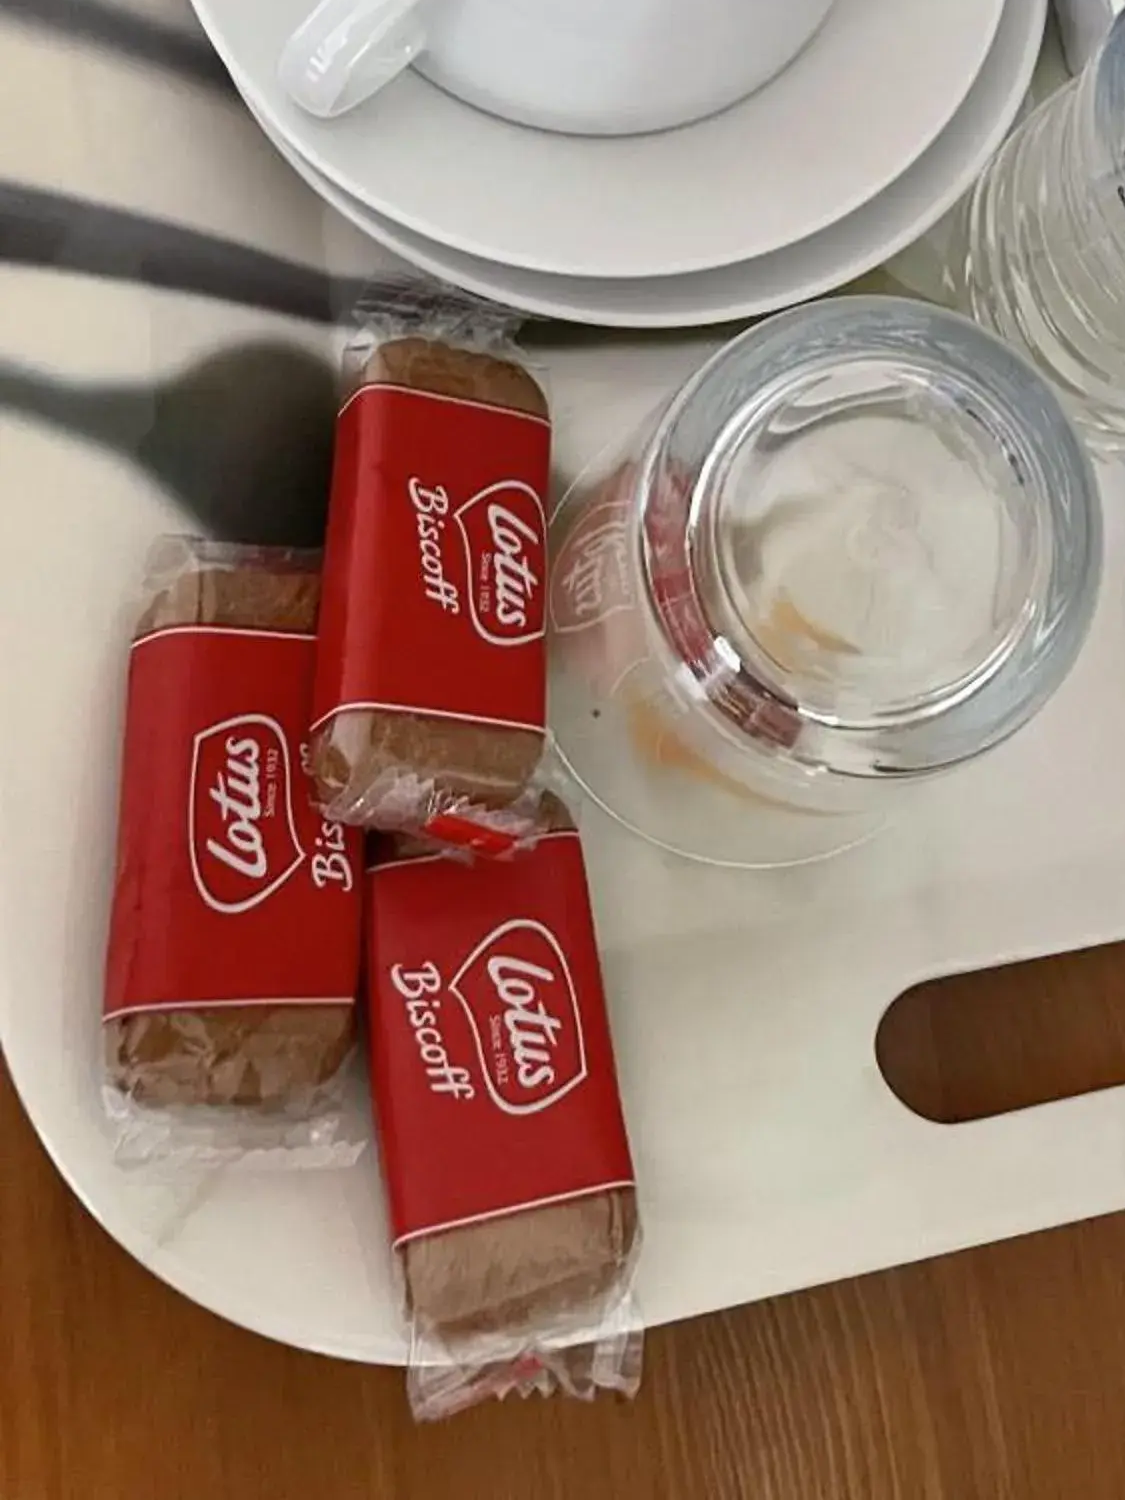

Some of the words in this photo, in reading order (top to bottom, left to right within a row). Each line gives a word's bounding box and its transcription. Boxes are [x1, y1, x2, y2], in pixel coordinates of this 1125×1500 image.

[408, 476, 460, 615] Biscoff
[486, 502, 540, 629] Lotus
[206, 736, 267, 880] Lotus
[389, 960, 476, 1103] Biscoff
[487, 954, 566, 1091] Lotus
